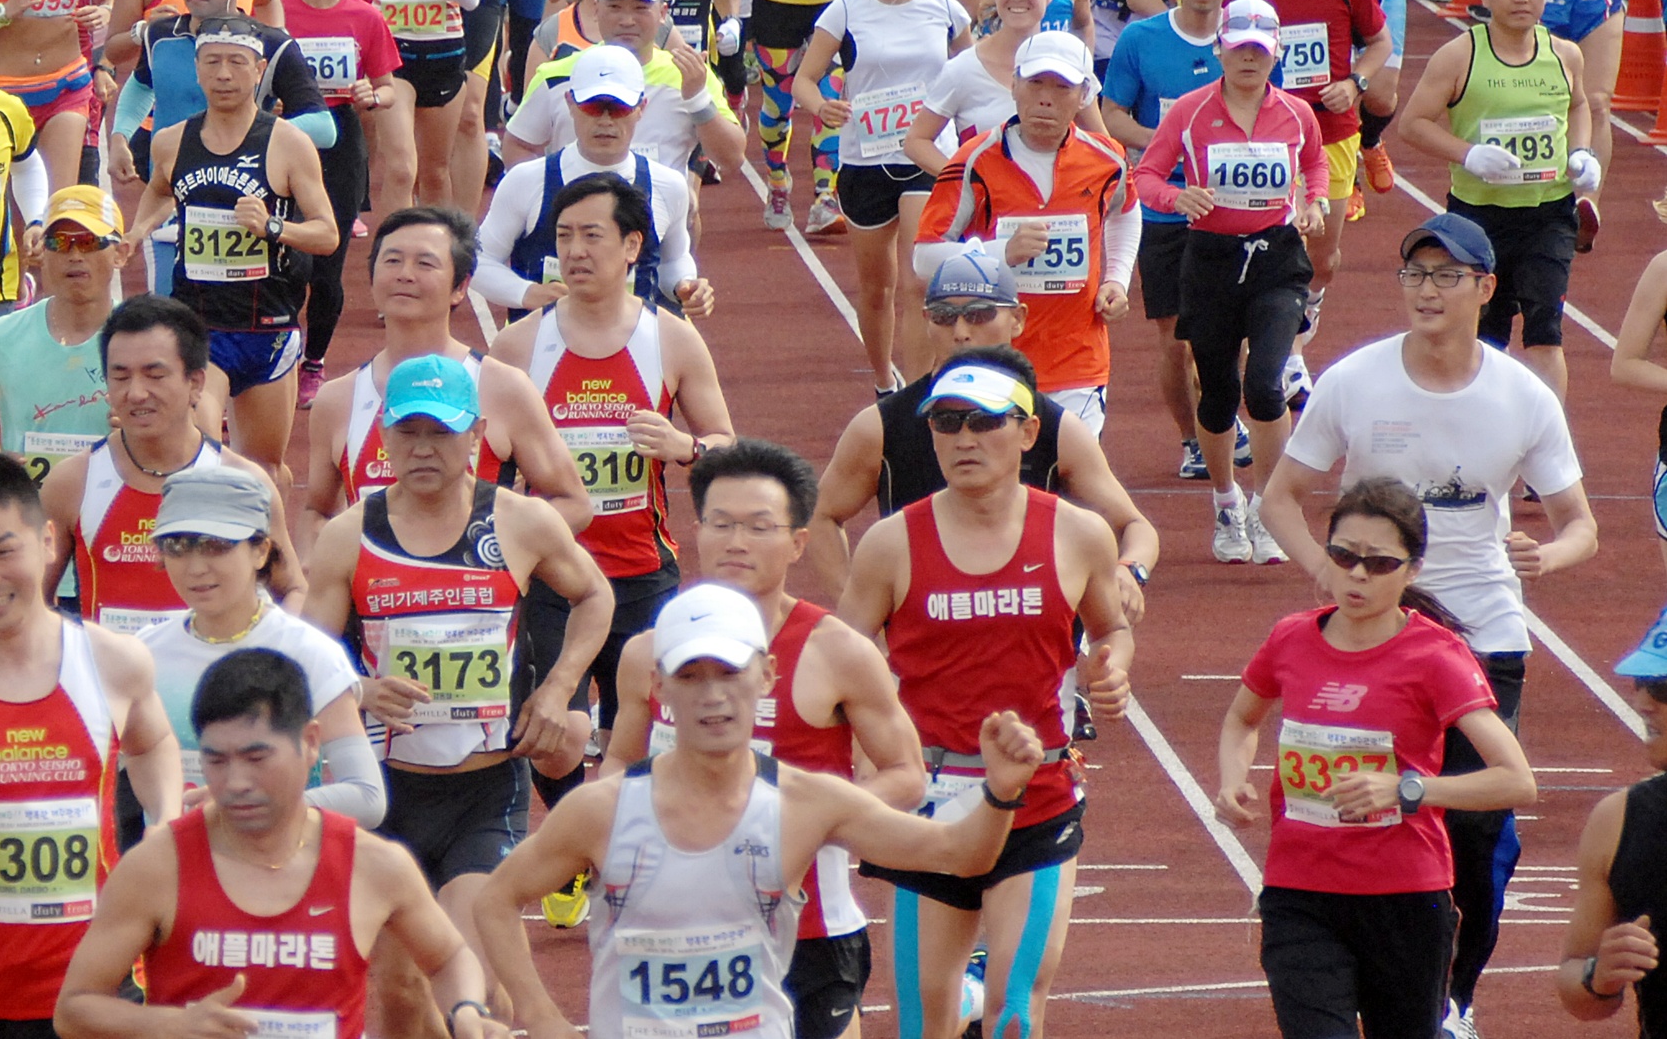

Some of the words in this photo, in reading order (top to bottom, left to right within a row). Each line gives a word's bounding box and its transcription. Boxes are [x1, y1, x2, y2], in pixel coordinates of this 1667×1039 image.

[381, 2, 443, 27] 2102
[1280, 40, 1325, 67] 750
[1486, 78, 1507, 90] THE
[1511, 77, 1547, 89] SHILLA
[859, 99, 924, 136] 1725
[1214, 161, 1287, 189] 1660
[188, 226, 265, 258] 3122
[1044, 280, 1065, 292] duty
[581, 378, 611, 391] new
[565, 390, 627, 404] balance
[567, 410, 608, 420] RUNNING
[609, 410, 633, 420] CLU
[568, 402, 602, 412] TOKYO
[603, 402, 636, 412] SEISHO
[580, 449, 646, 486] 310
[602, 499, 624, 510] duty
[365, 585, 495, 614] 달리기제주인클럽
[926, 586, 1044, 622] 애플마라톤
[396, 648, 503, 691] 3173
[452, 707, 478, 719] duty
[481, 706, 506, 717] free
[6, 727, 46, 744] new
[38, 758, 82, 771] SEISHO
[49, 768, 86, 783] CLUB
[33, 904, 63, 919] duty
[65, 902, 92, 917] free
[191, 928, 337, 971] 애플마라톤
[629, 954, 756, 1006] 1548
[698, 1021, 728, 1037] duty
[732, 1015, 760, 1031] free
